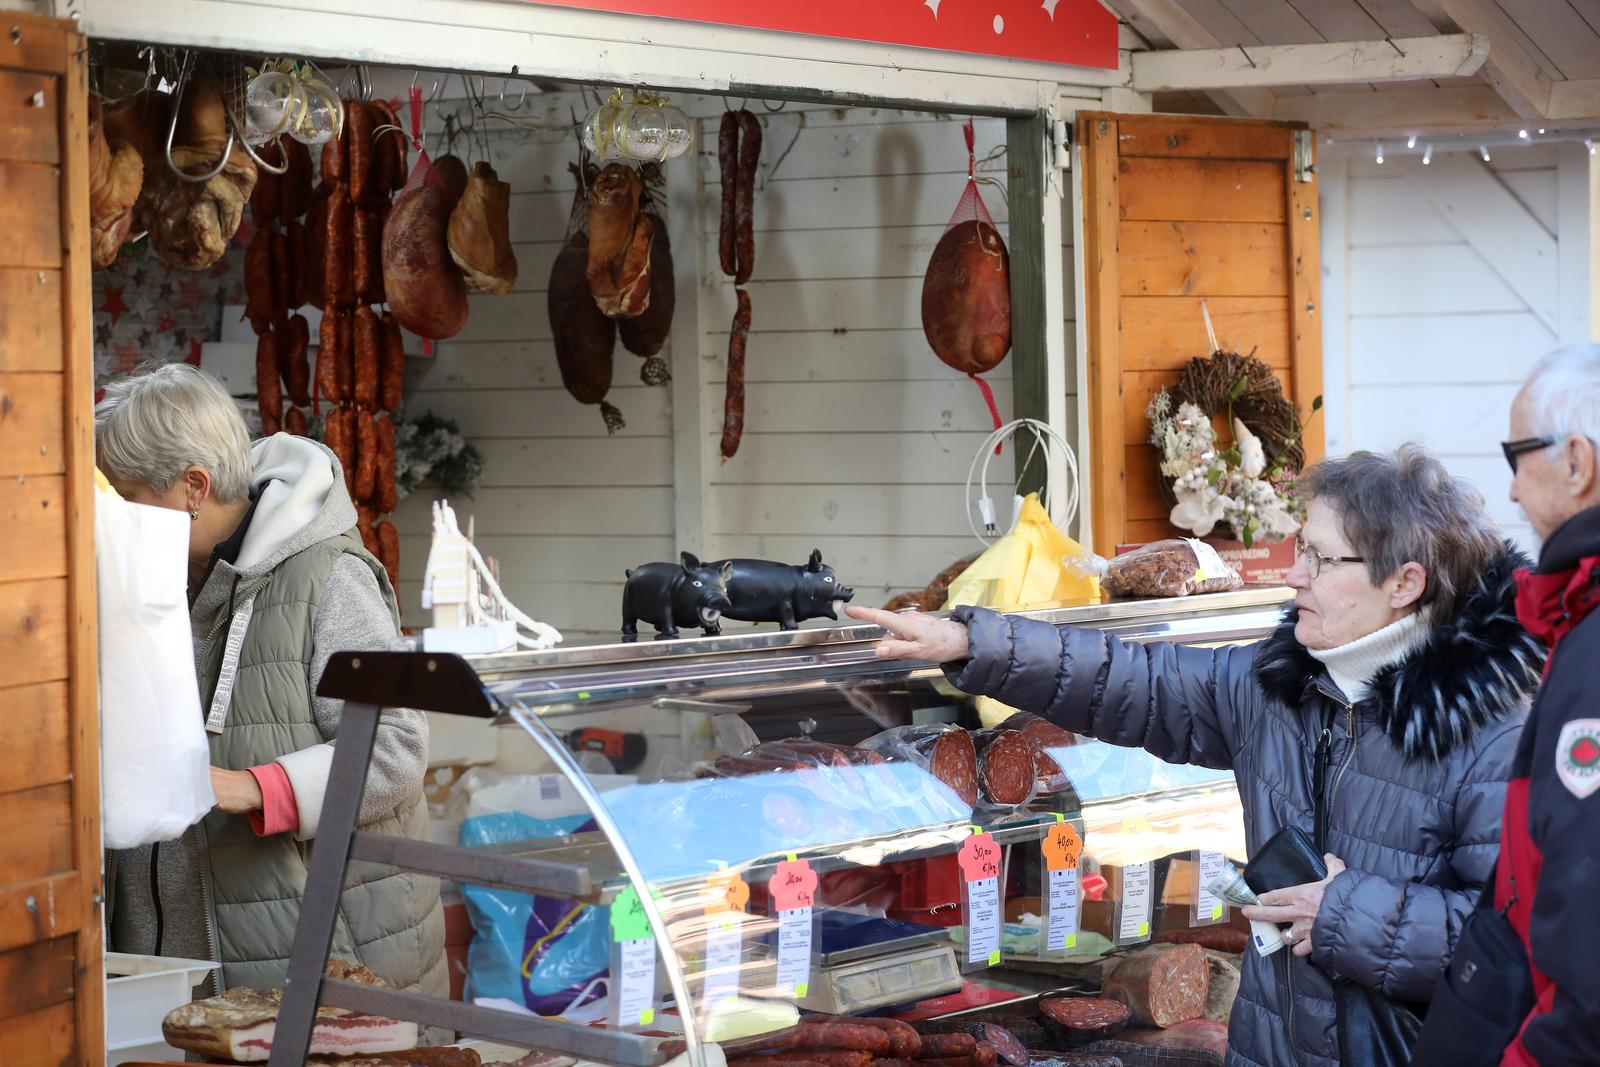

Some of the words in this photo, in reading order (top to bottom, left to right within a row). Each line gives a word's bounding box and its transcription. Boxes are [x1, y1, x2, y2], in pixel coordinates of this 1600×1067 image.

[232, 611, 249, 630] GET
[224, 634, 241, 662] YOUR
[215, 665, 234, 698] STYLE
[1057, 833, 1074, 851] 40,00
